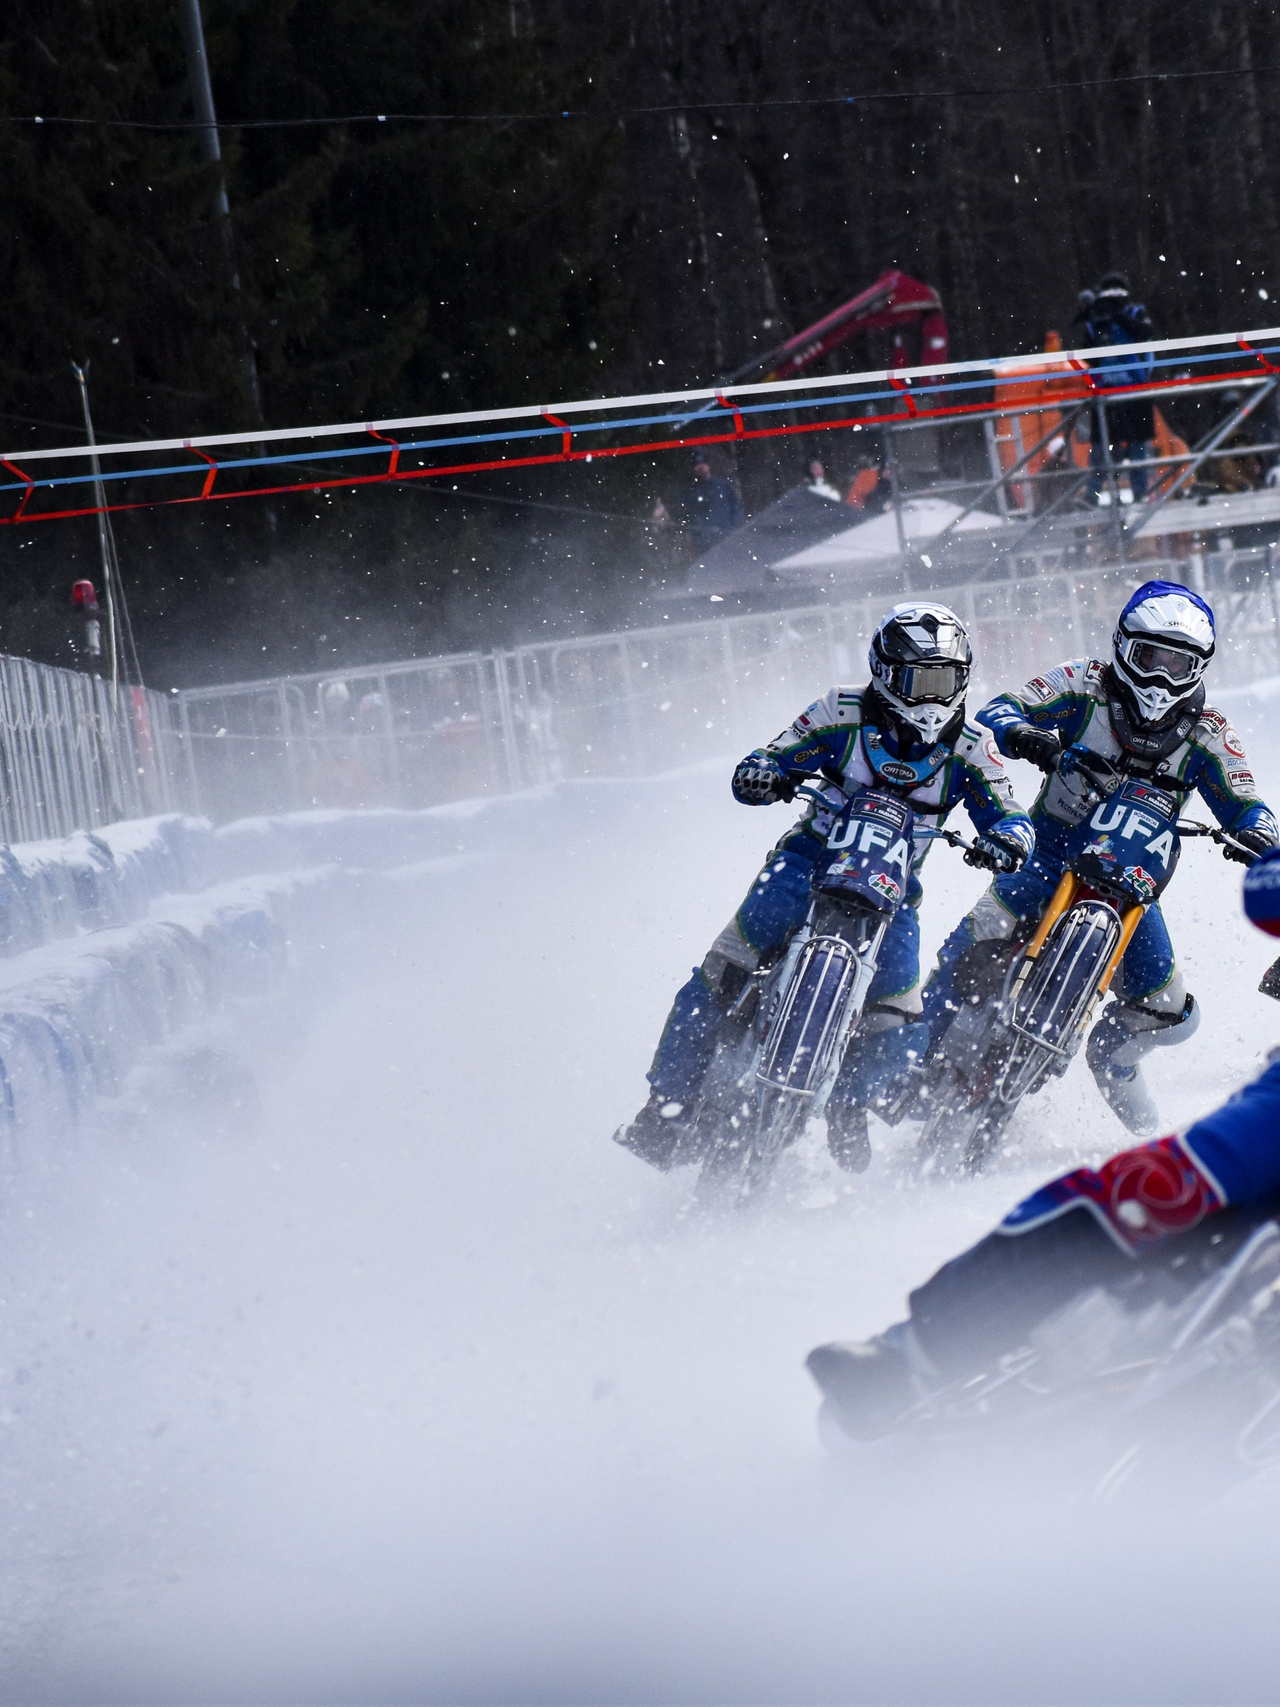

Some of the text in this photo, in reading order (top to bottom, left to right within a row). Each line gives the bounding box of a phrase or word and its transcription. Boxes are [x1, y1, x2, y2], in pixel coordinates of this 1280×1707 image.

[1132, 737, 1159, 749] ORTEMA
[883, 765, 914, 779] ORTEMA
[827, 820, 908, 879] UFA
[1090, 802, 1174, 870] UFA
